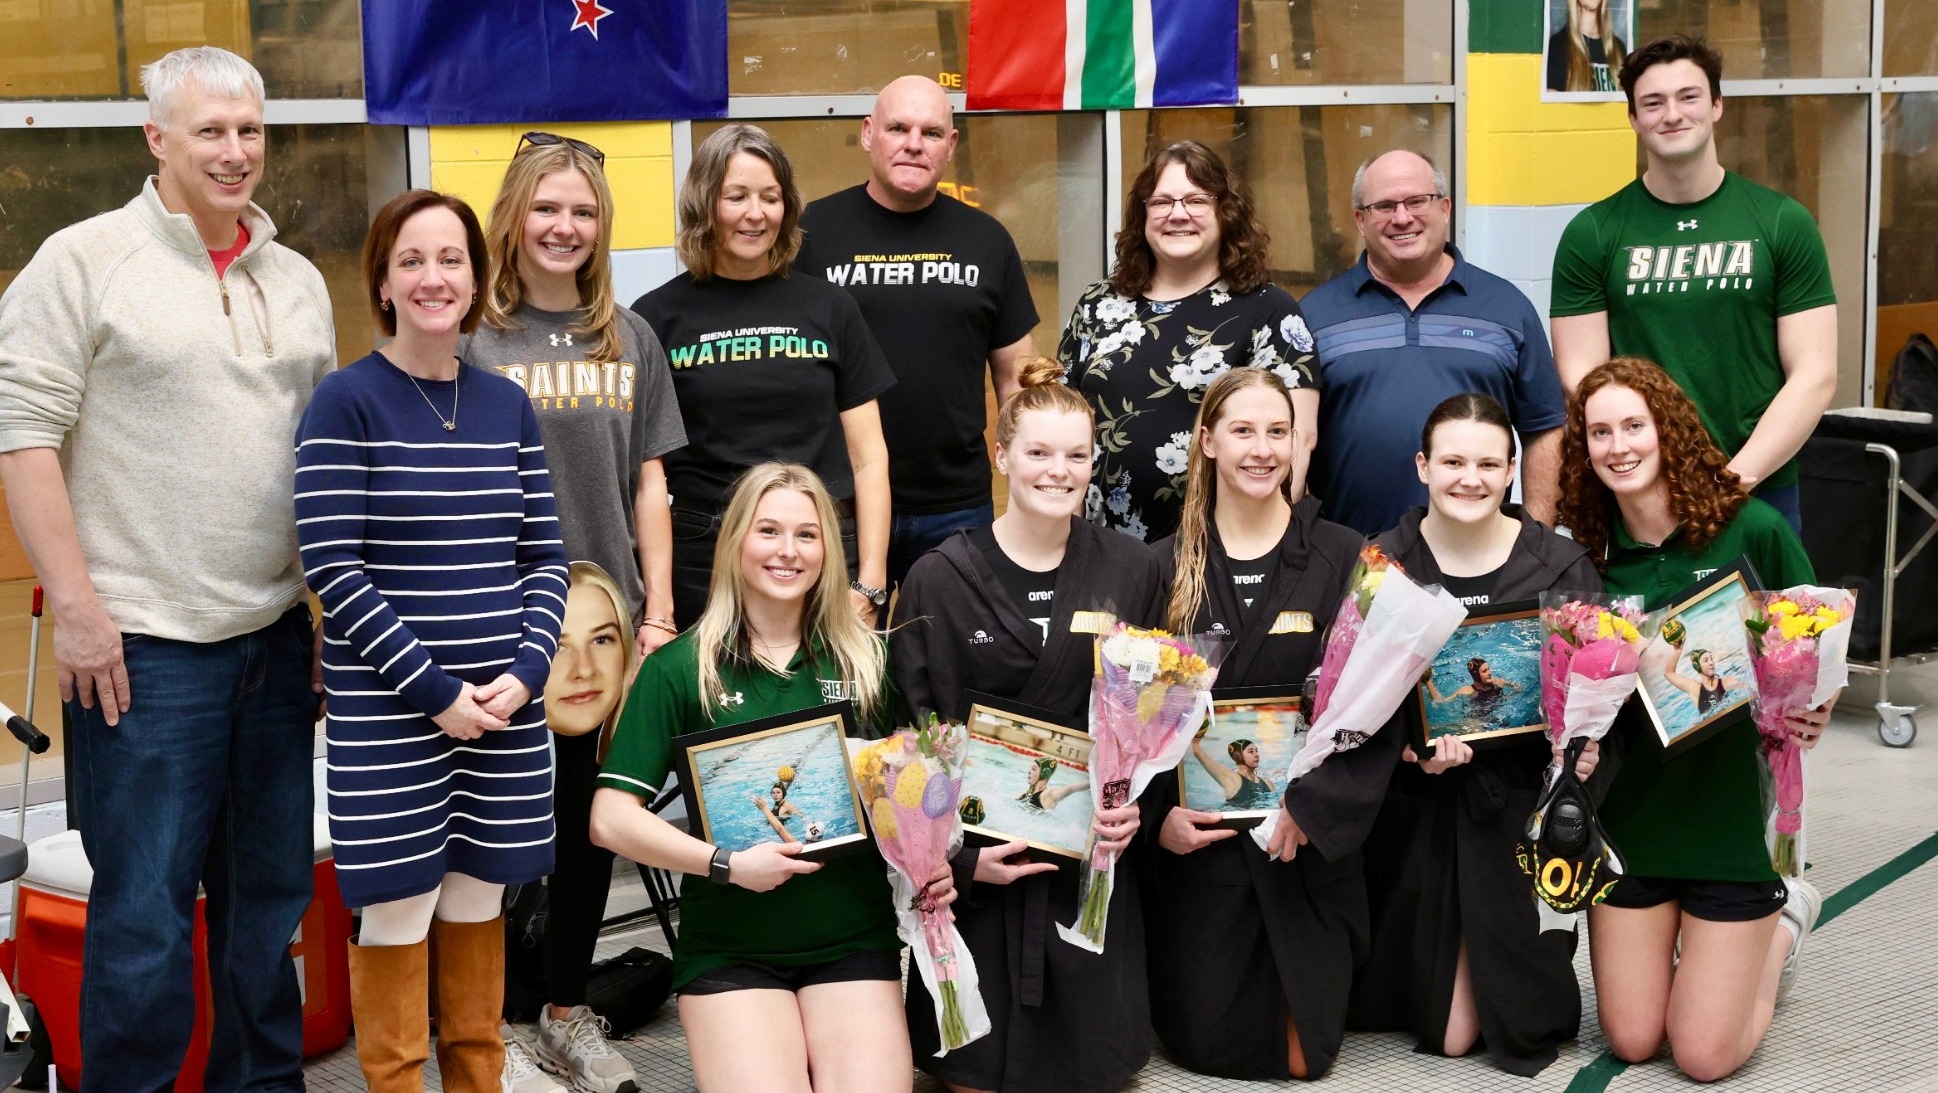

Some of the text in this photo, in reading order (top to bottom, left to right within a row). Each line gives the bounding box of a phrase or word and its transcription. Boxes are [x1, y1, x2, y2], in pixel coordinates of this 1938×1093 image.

[854, 253, 952, 262] SIENA UNIVERSITY
[1622, 240, 1754, 281] SIENA
[826, 261, 980, 287] WATER POLO
[1626, 277, 1753, 296] WATER POLO
[700, 326, 798, 342] SIENA UNIVERSITY
[670, 335, 829, 370] WATER POLO
[495, 361, 636, 399] SAINTS
[541, 396, 634, 412] TER POLO
[1028, 590, 1054, 602] aren
[1460, 594, 1489, 606] rena
[1268, 610, 1314, 635] AINTS
[968, 637, 994, 645] TURBO
